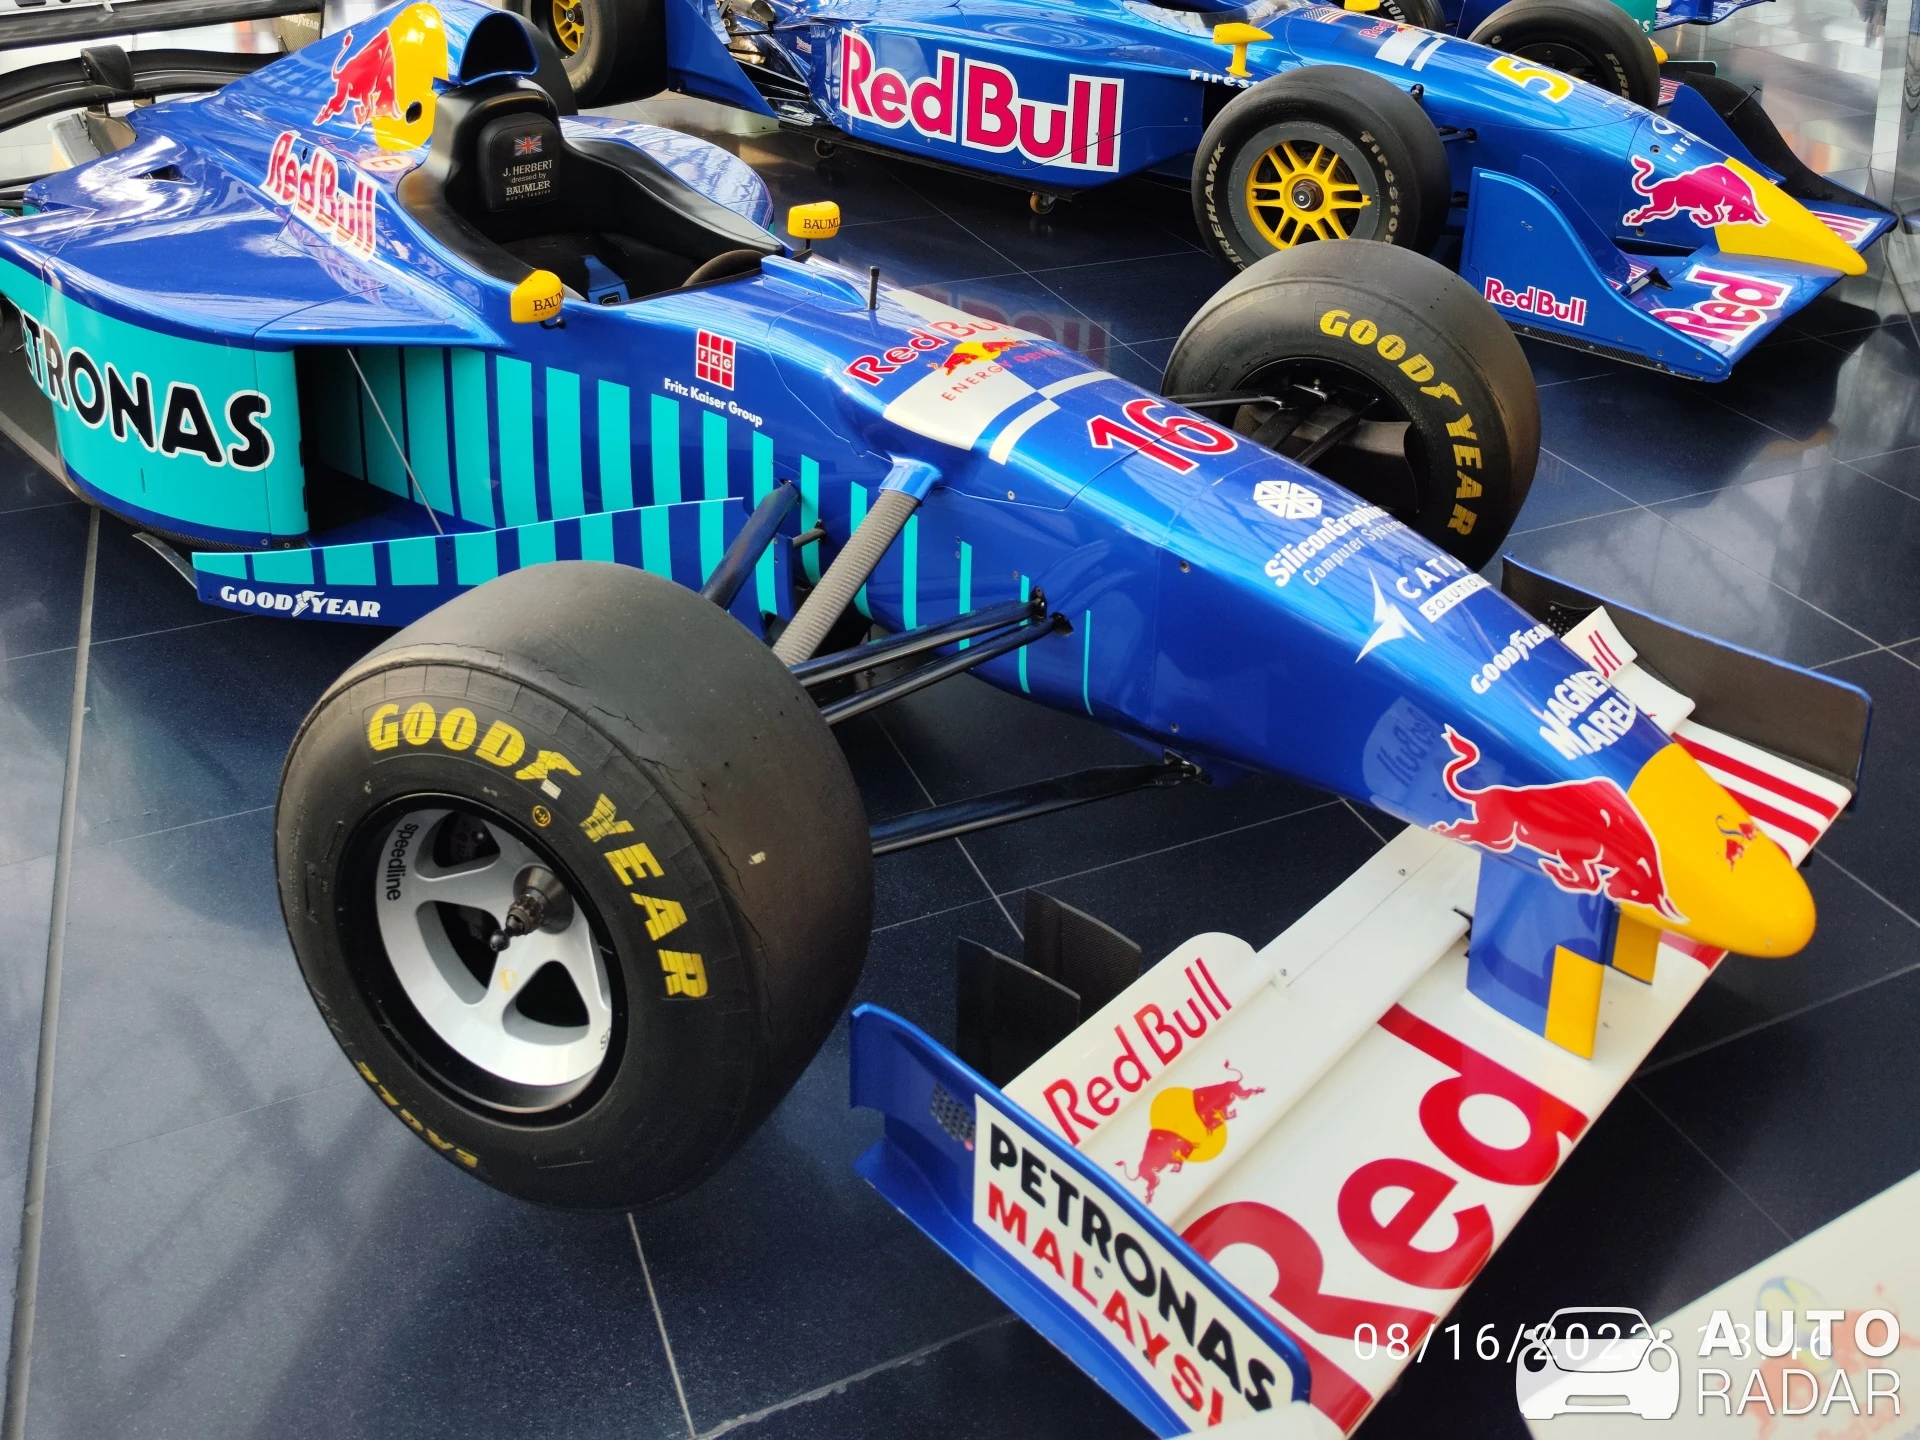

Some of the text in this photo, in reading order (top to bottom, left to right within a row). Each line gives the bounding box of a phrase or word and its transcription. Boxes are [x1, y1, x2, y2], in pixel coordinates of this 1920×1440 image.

[841, 32, 1118, 167] Red Bull
[1486, 56, 1574, 103] 5
[265, 131, 375, 255] Red Bull
[502, 159, 553, 177] J. HERBERT
[511, 172, 547, 184] dressed by
[1485, 278, 1585, 324] Red Bull
[1652, 269, 1788, 344] Red
[844, 329, 950, 386] Red
[941, 361, 1013, 402] ENERGY
[664, 377, 763, 428] Fritz Kaiser Group
[1087, 398, 1238, 475] 16
[1302, 535, 1366, 587] Computer
[386, 822, 419, 902] speedline
[1042, 956, 1233, 1146] Red Bull
[1178, 1002, 1590, 1437] Red
[989, 1121, 1276, 1412] PETRONAS
